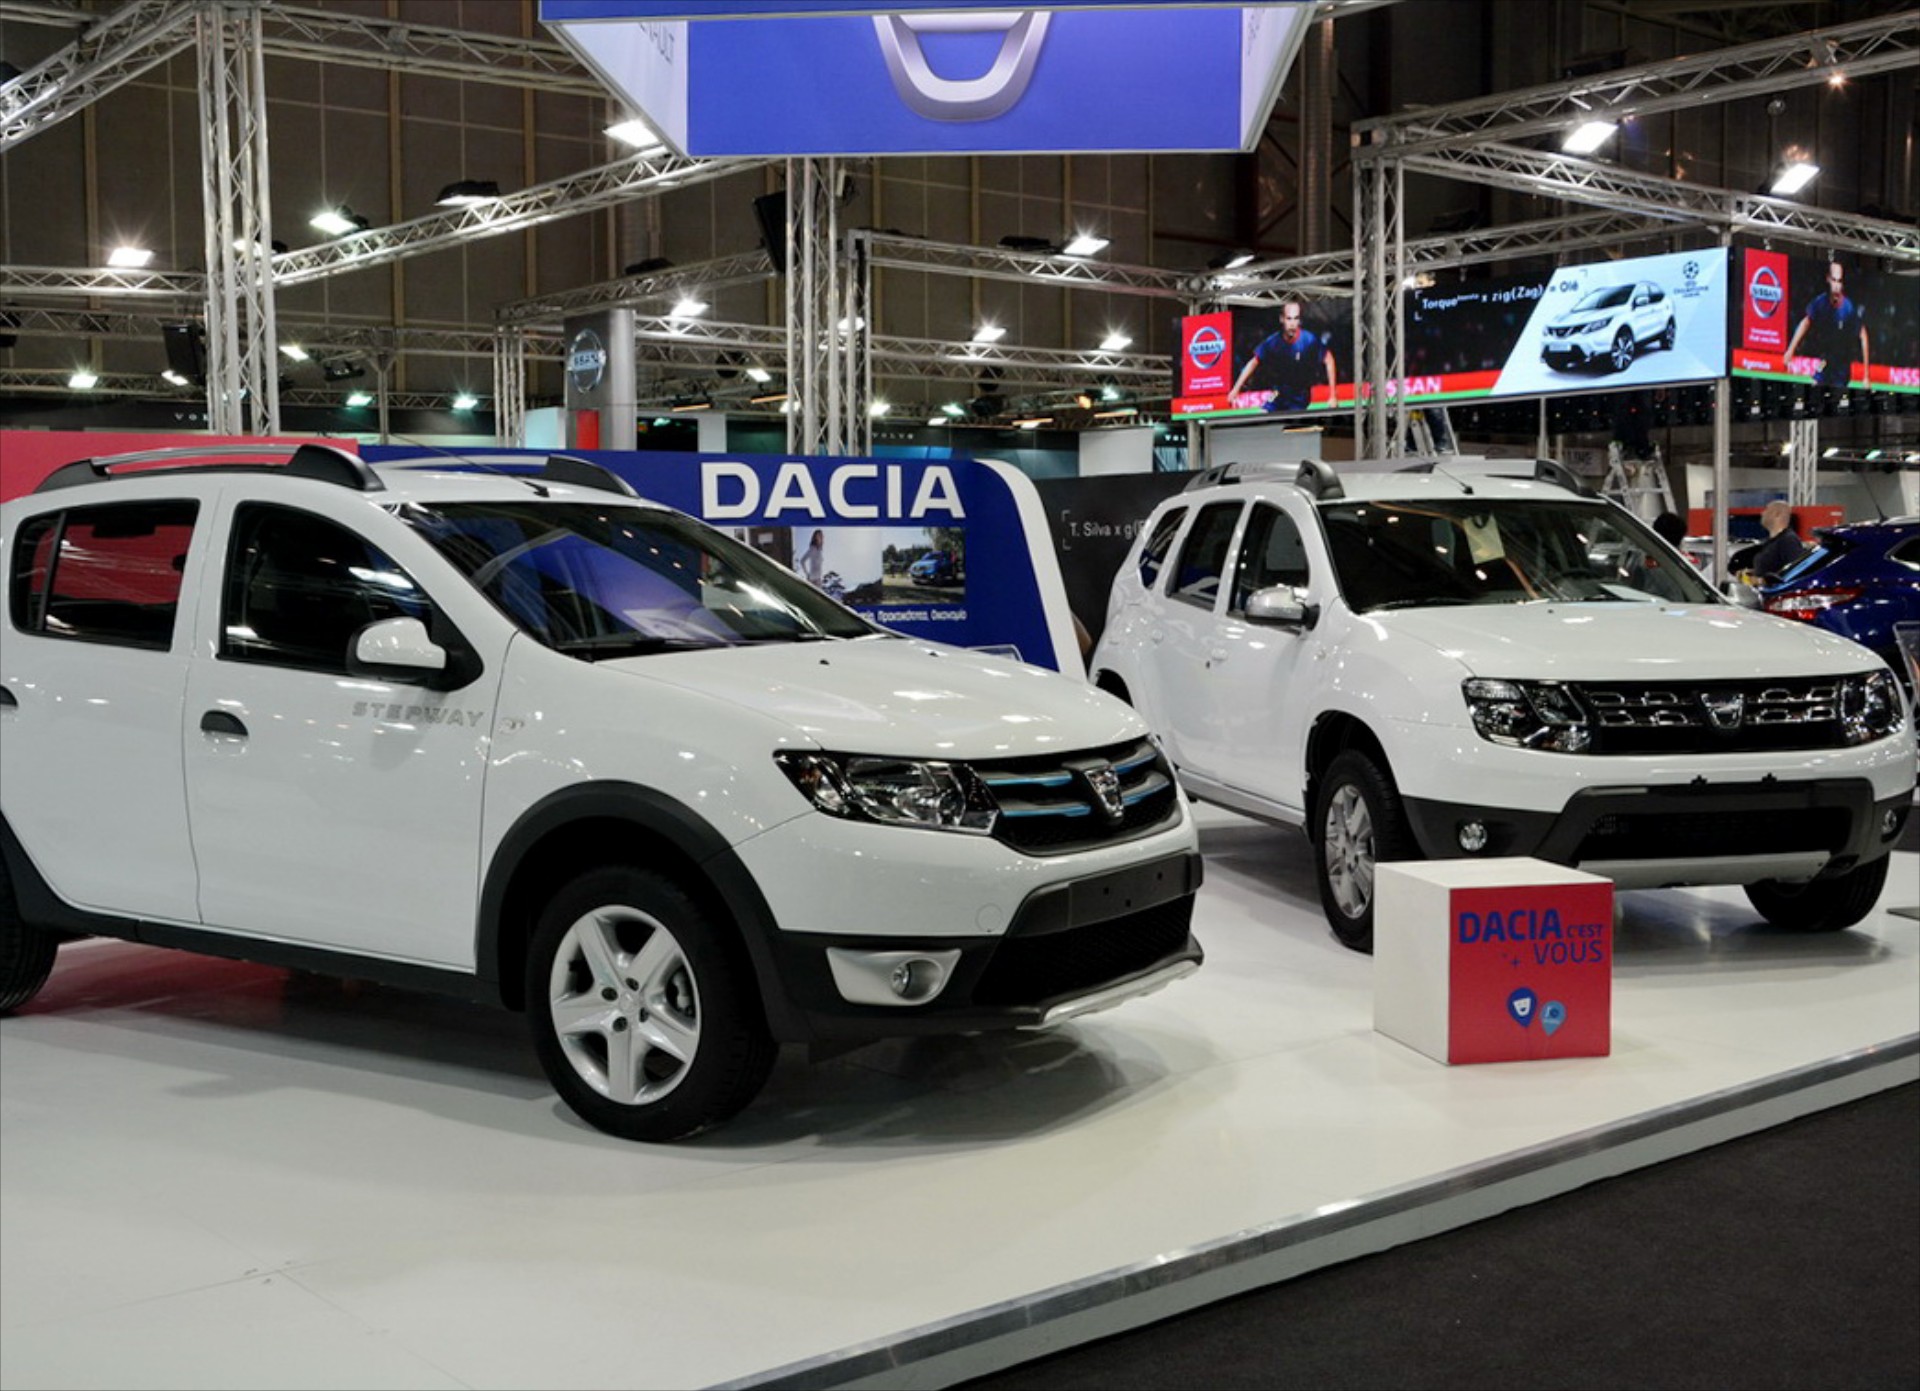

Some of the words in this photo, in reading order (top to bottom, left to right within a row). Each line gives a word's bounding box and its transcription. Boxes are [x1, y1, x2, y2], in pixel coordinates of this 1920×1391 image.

[701, 462, 967, 518] DACIA
[1083, 521, 1112, 537] Silva
[351, 701, 484, 728] STEPWAY
[1459, 908, 1562, 943] DACIA
[1567, 924, 1604, 939] C'EST
[1534, 939, 1604, 965] VOUS
